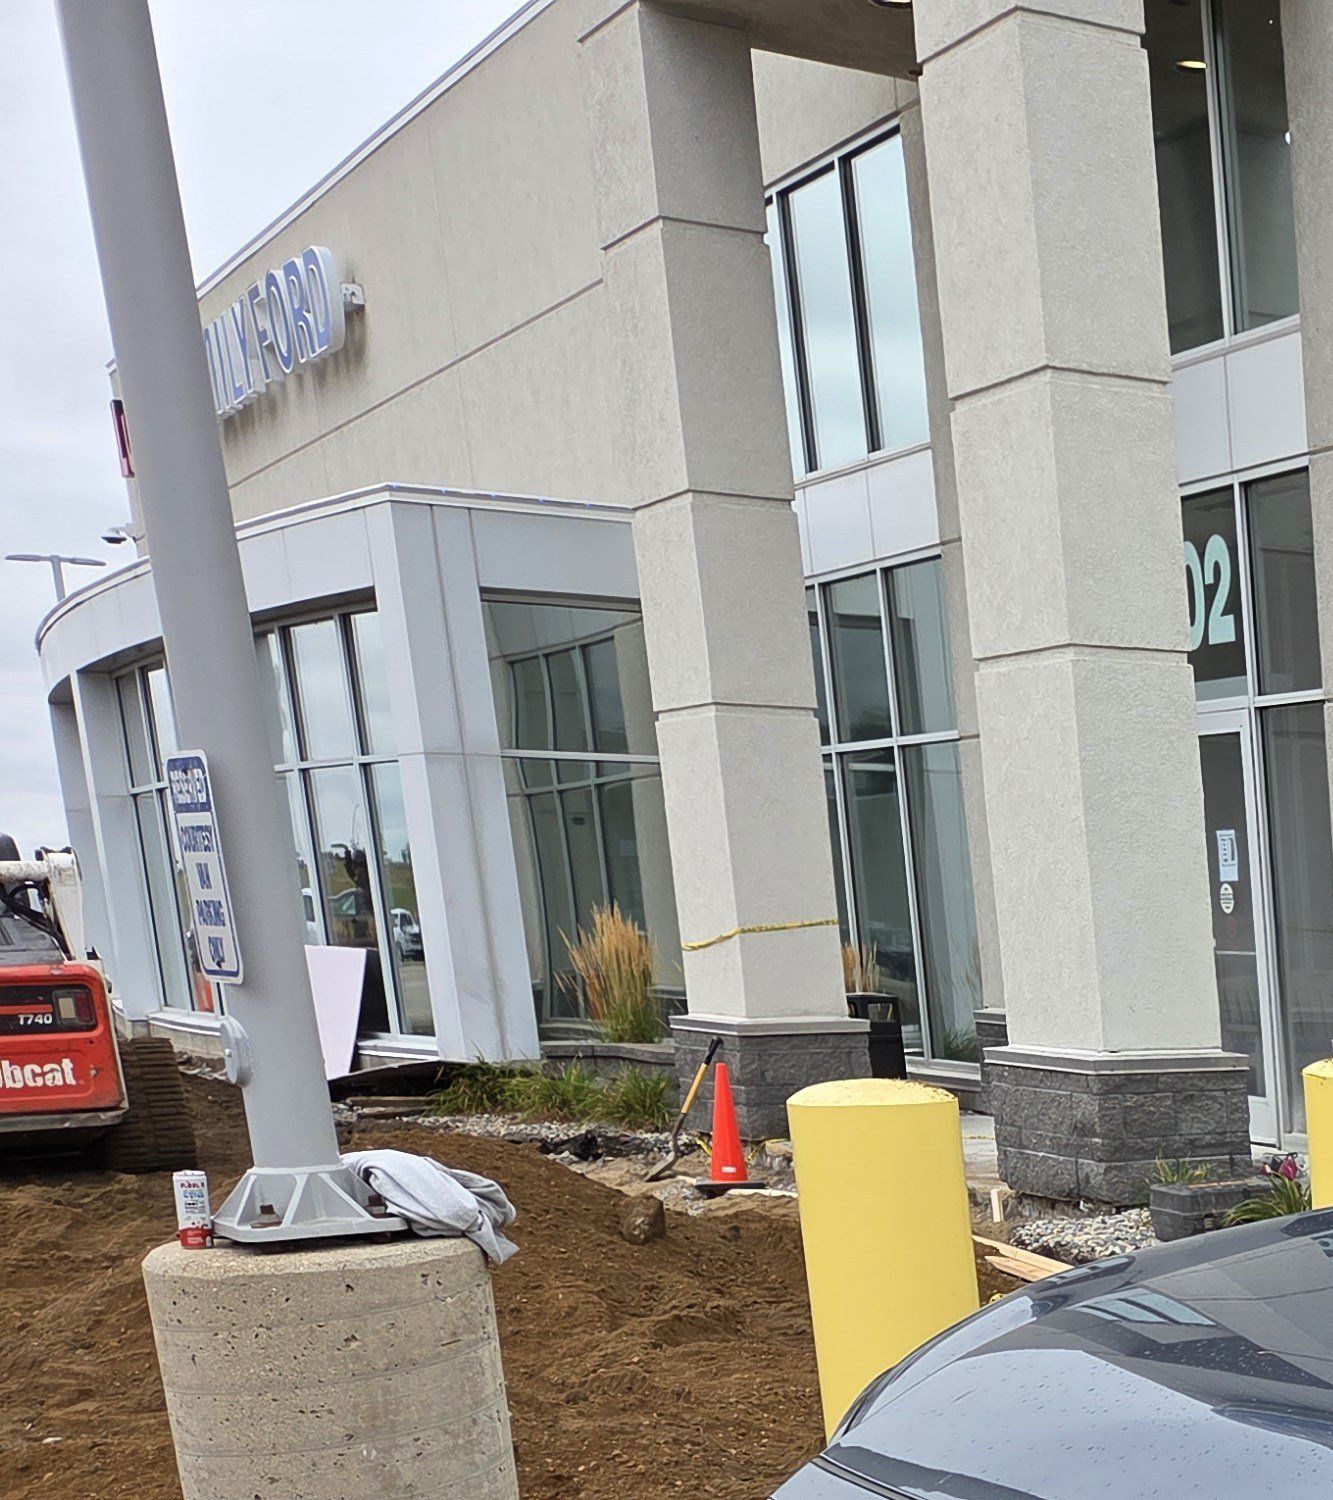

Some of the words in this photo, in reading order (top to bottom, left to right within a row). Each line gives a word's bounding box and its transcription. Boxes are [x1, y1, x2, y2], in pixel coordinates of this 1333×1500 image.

[203, 296, 254, 415] ILY
[246, 246, 335, 384] FORD
[18, 1013, 53, 1026] T740
[0, 1057, 77, 1089] bcat
